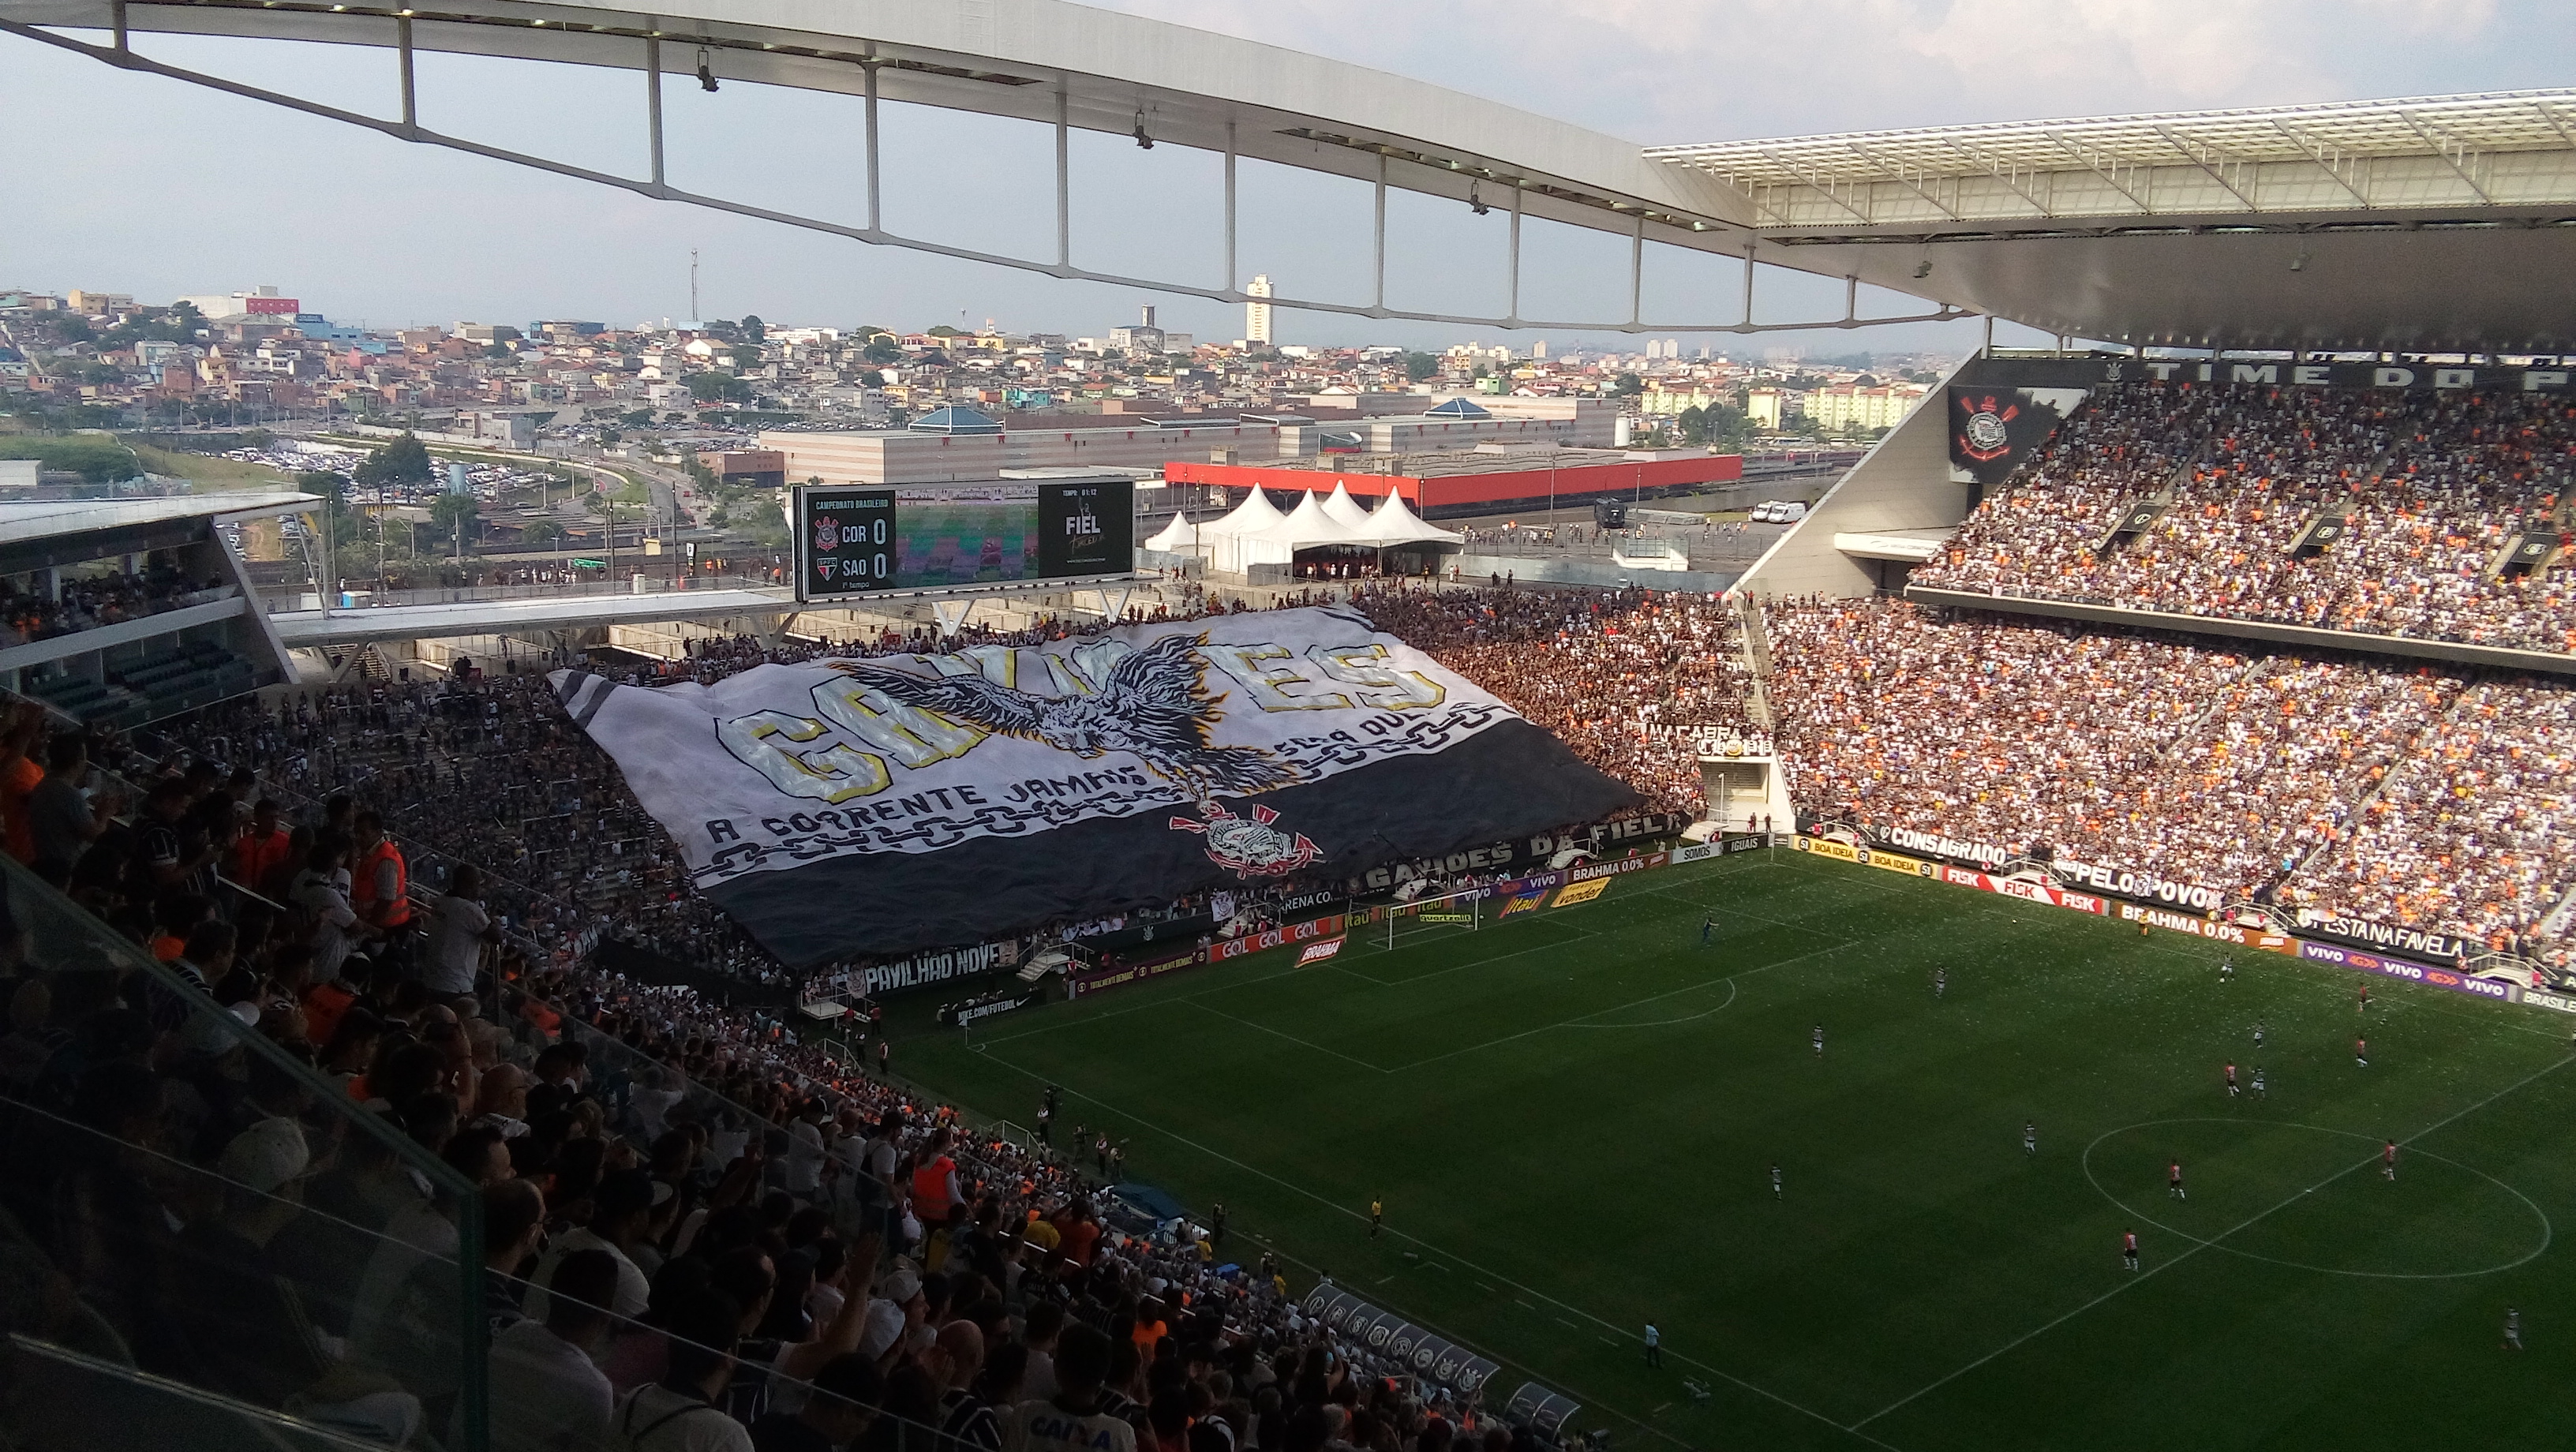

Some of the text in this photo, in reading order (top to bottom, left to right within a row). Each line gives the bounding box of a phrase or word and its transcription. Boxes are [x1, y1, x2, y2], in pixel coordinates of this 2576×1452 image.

[2147, 361, 2331, 385] TIME
[2374, 367, 2475, 389] DO
[815, 499, 889, 510] CAMPEONATO BRASILEIRO
[842, 518, 886, 545] COR 0
[1065, 515, 1101, 535] FIEL
[874, 552, 887, 579] 0
[706, 818, 741, 844] A
[761, 786, 987, 836] CORRENTE
[1003, 765, 1148, 803] JAMAIS
[1589, 815, 1663, 844] FIEL
[1683, 845, 1711, 861] SOMOS
[1730, 837, 1758, 852] IGUAIS
[1815, 842, 1854, 859] BOA IDEIA
[1874, 855, 1915, 872] BOA IDEIA
[1891, 826, 2007, 866] CONSAGRADO
[2075, 863, 2136, 893] PELO
[1573, 863, 1619, 881] BRAHMA
[1947, 868, 1979, 887] FISK
[2004, 881, 2035, 898] FISK
[2061, 893, 2095, 912] FISK
[2121, 904, 2200, 935] BRAHMA
[1258, 929, 1286, 949] GOL
[1294, 921, 1320, 940] GOL
[1222, 939, 1249, 958] GOL
[956, 943, 1000, 976] NOVE
[1030, 1416, 1110, 1450] CAIXA
